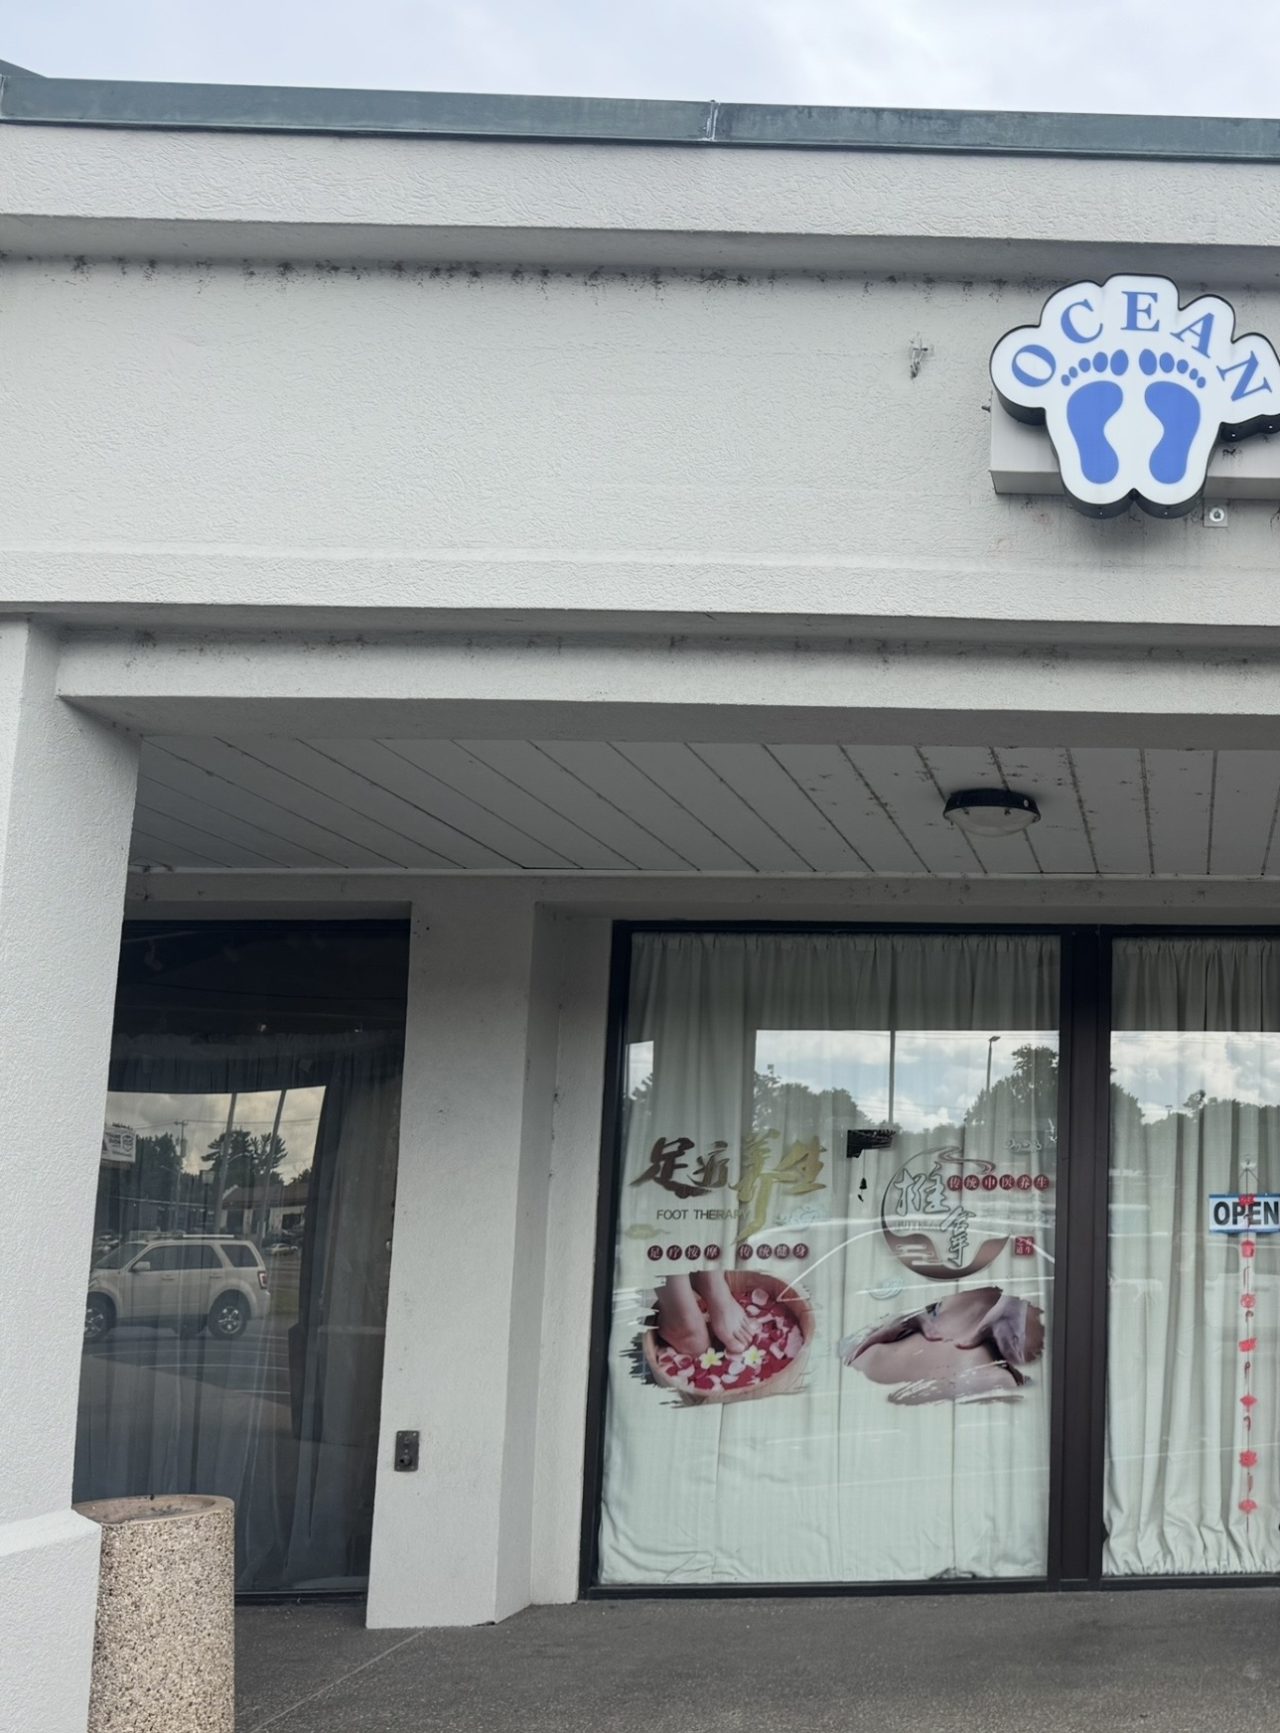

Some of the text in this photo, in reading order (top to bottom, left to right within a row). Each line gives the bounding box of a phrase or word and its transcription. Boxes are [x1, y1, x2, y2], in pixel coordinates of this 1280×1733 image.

[1011, 291, 1273, 402] OCEAN
[657, 1209, 689, 1220] FOOT
[1213, 1201, 1279, 1225] OPEN
